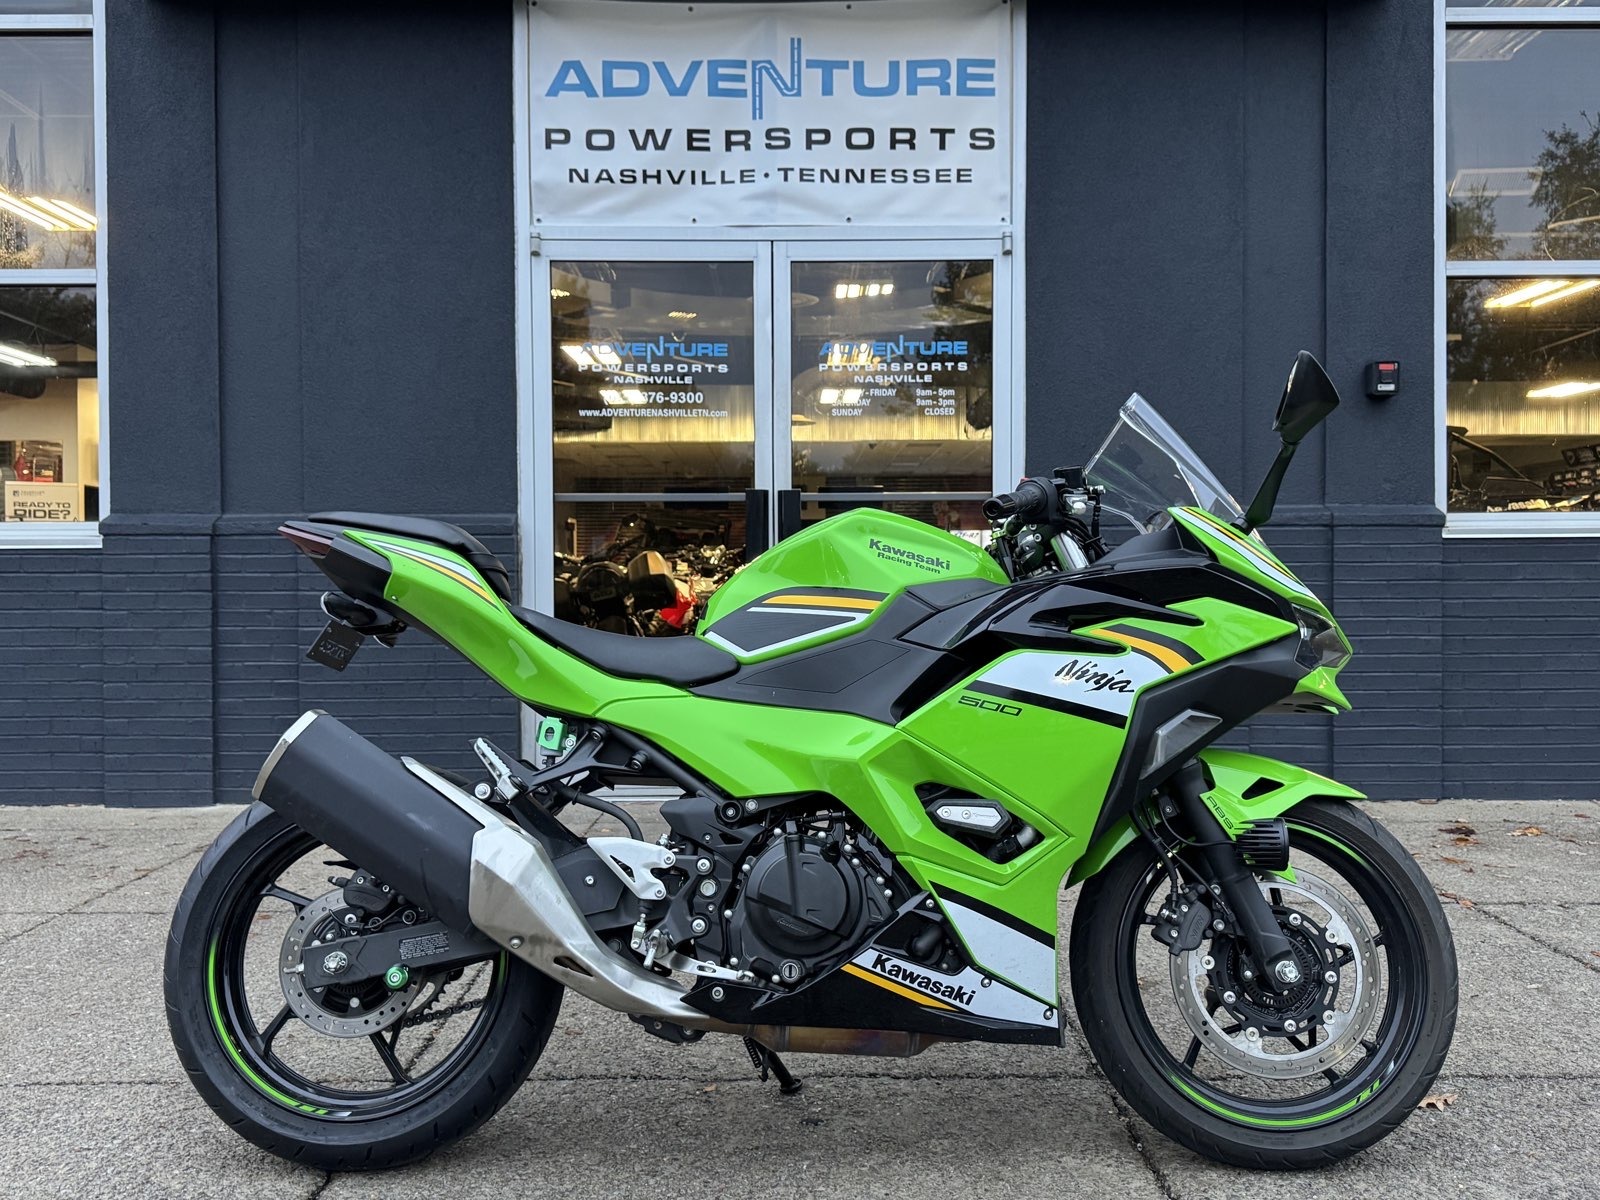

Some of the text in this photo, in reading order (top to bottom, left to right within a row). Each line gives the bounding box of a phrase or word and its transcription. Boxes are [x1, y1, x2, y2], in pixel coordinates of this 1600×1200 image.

[544, 37, 996, 121] ADVENTURE
[544, 127, 996, 152] POWERSPORTS
[568, 167, 973, 185] NASHVILLE TENNESSEE
[819, 335, 968, 362] ADVENTURE
[578, 364, 729, 373] POWERSPORTS
[818, 362, 968, 372] POWERSPORTS
[614, 376, 693, 384] NASHVILLE
[854, 374, 933, 383] NASHVILLE
[869, 388, 897, 396] FRIDAY
[578, 408, 728, 417] www.ADVENTURENASHVILLETN.com
[832, 408, 863, 416] SUNDAY
[924, 407, 956, 416] CLOSED
[13, 508, 71, 519] RIDE?
[869, 538, 951, 571] Kawasaki
[877, 552, 941, 574] Racing Team
[1054, 659, 1135, 693] Ninja
[958, 695, 1023, 717] 500
[1206, 796, 1234, 829] ABS
[871, 953, 977, 1006] Kawasaki
